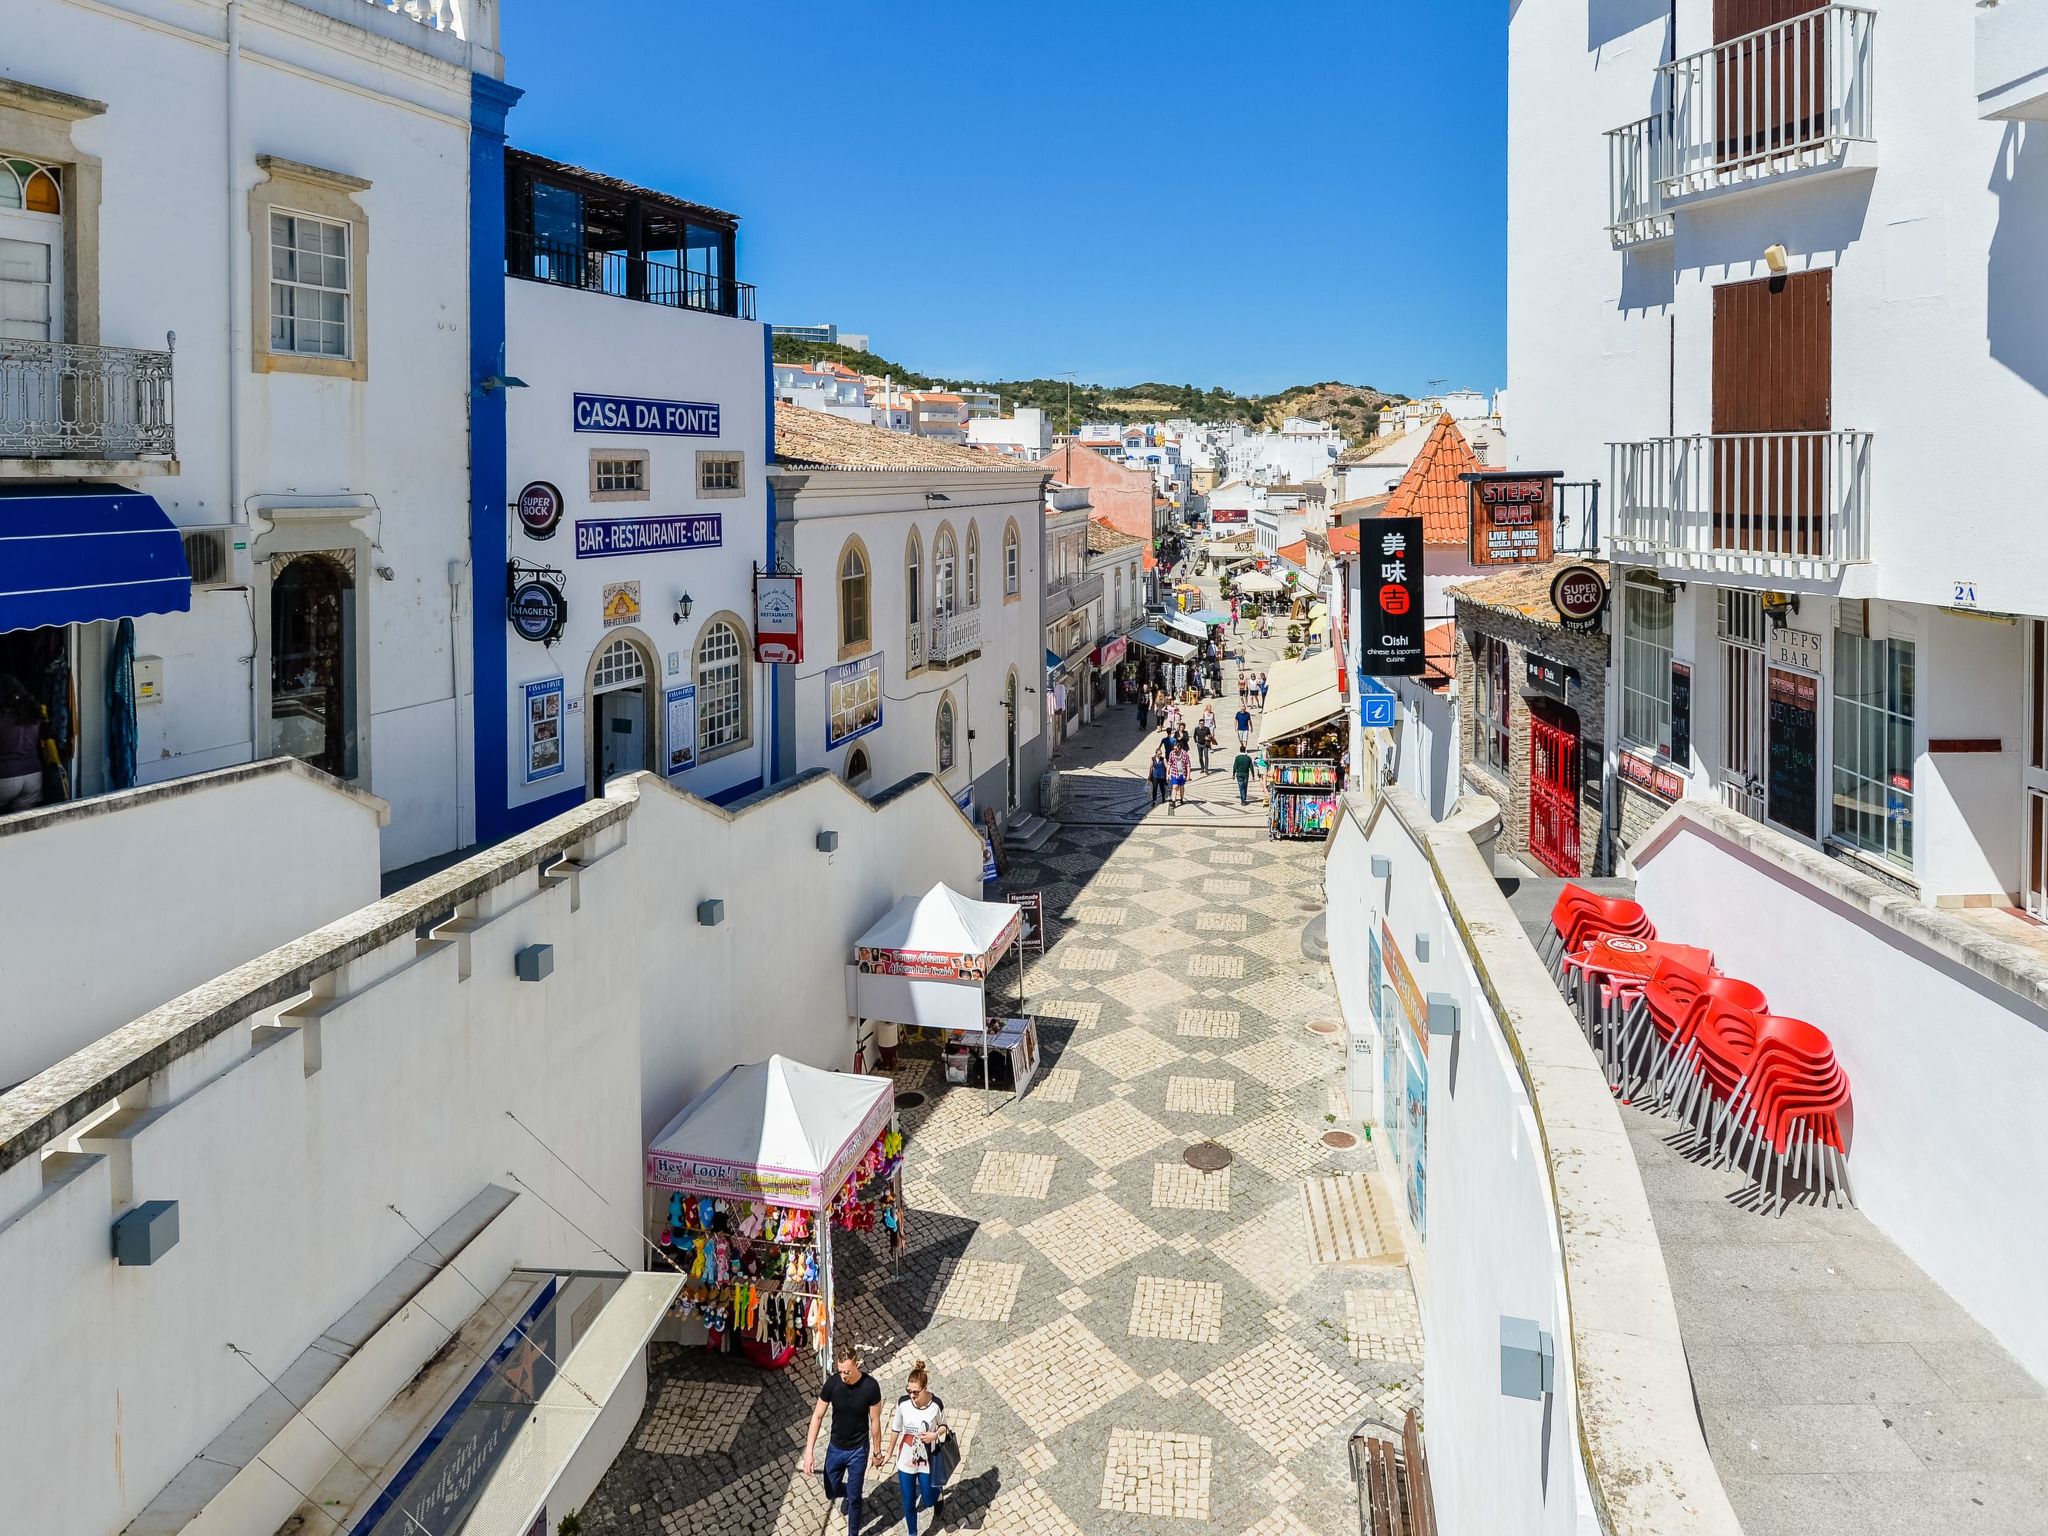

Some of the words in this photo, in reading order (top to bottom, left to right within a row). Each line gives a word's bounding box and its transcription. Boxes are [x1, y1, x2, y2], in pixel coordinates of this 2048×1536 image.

[577, 401, 630, 427] CASA
[636, 405, 661, 429] DA
[666, 408, 718, 432] FONTE
[1483, 481, 1543, 502] STEPS
[523, 497, 550, 507] SUPER
[524, 506, 549, 516] BOCK
[1494, 505, 1533, 525] BAR
[1488, 531, 1508, 540] LIVE
[1512, 530, 1538, 539] MUSIC
[1490, 549, 1519, 558] SPORTS
[1521, 548, 1537, 557] BAR
[1563, 583, 1597, 595] SUPER
[1955, 586, 1976, 602] 2A
[1566, 593, 1596, 605] BOCK
[513, 606, 555, 617] MAGNERS
[1566, 620, 1584, 630] STEPS
[1381, 635, 1409, 646] Oishi
[1771, 627, 1819, 650] STEPS
[1395, 648, 1421, 656] japanese
[1780, 647, 1809, 667] BAR
[1623, 755, 1652, 788] STEPS
[1656, 770, 1679, 800] BAR
[658, 1159, 687, 1175] Hey!
[692, 1162, 731, 1180] Look!
